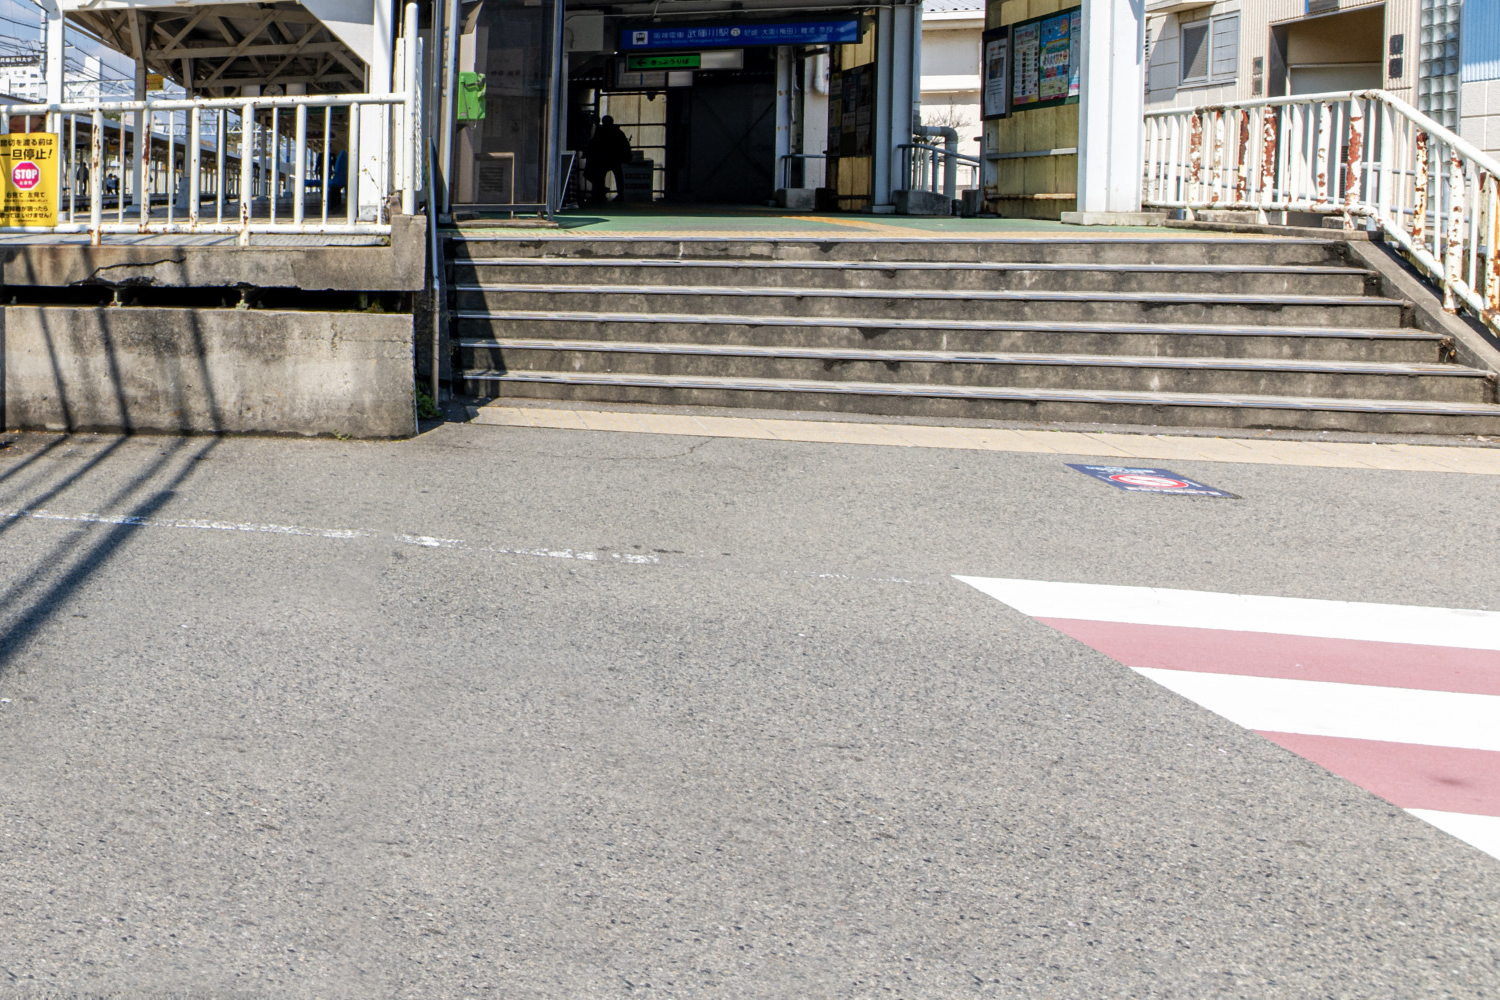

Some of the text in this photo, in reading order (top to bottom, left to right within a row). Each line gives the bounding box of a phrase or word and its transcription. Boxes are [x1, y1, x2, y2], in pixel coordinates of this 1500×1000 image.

[687, 28, 729, 39] 武庫川駅
[0, 148, 53, 161] 一旦停止！
[14, 169, 38, 180] STOP
